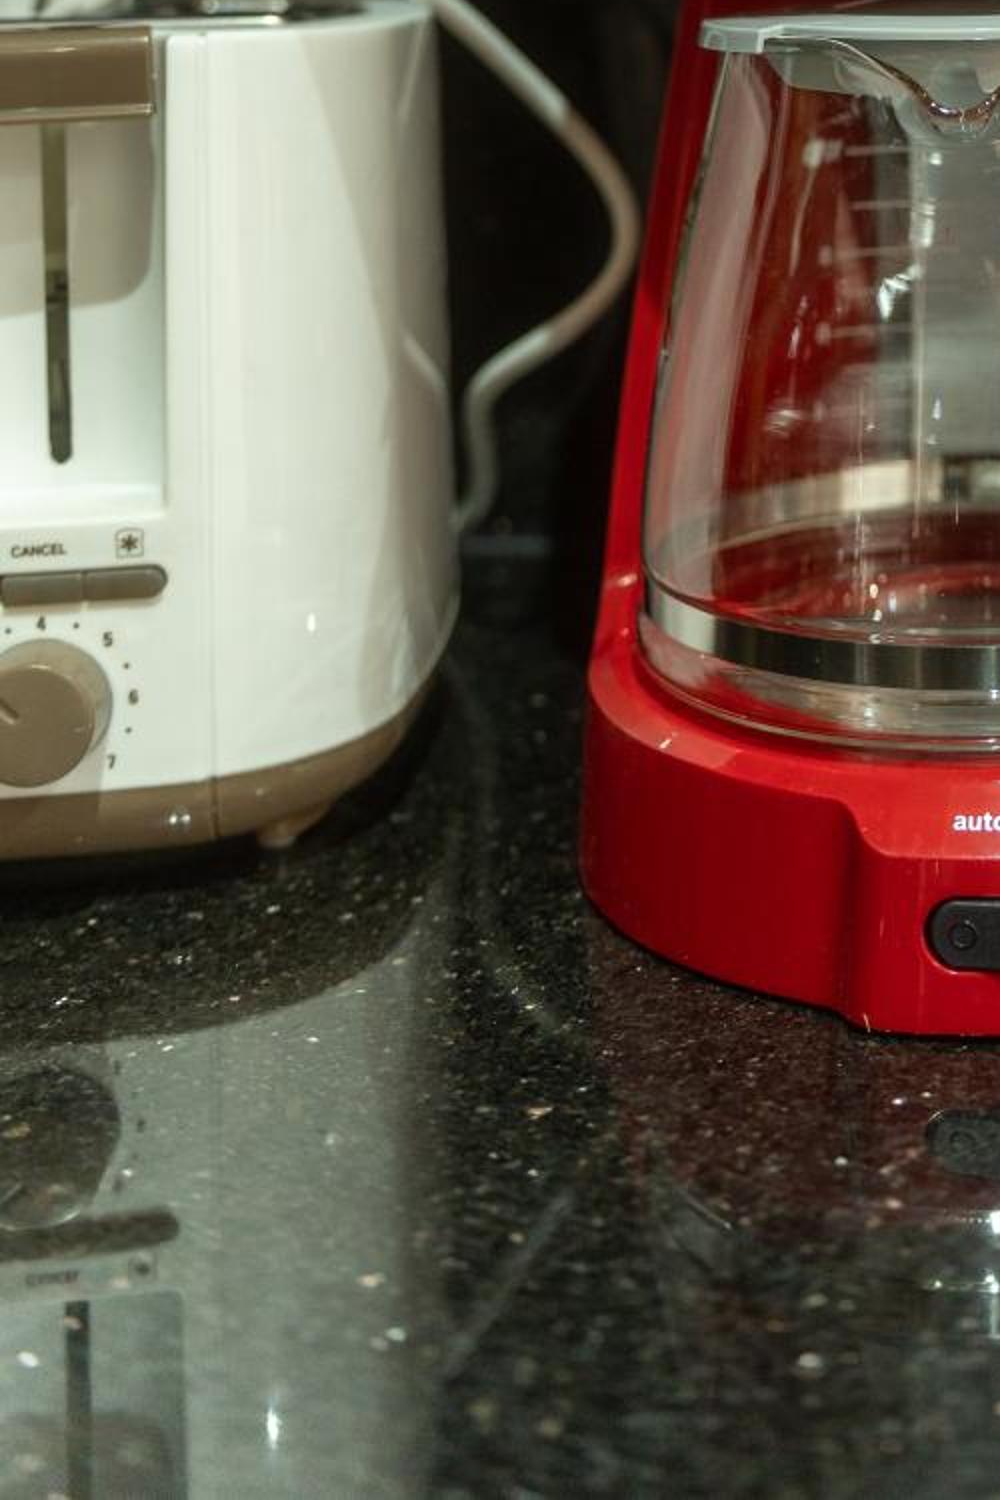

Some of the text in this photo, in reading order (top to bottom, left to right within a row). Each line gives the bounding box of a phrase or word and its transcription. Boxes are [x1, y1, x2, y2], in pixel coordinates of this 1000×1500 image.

[11, 543, 67, 558] CANCEL
[36, 616, 47, 631] 4
[103, 631, 114, 647] 5
[128, 689, 139, 705] 6
[107, 754, 117, 769] 7
